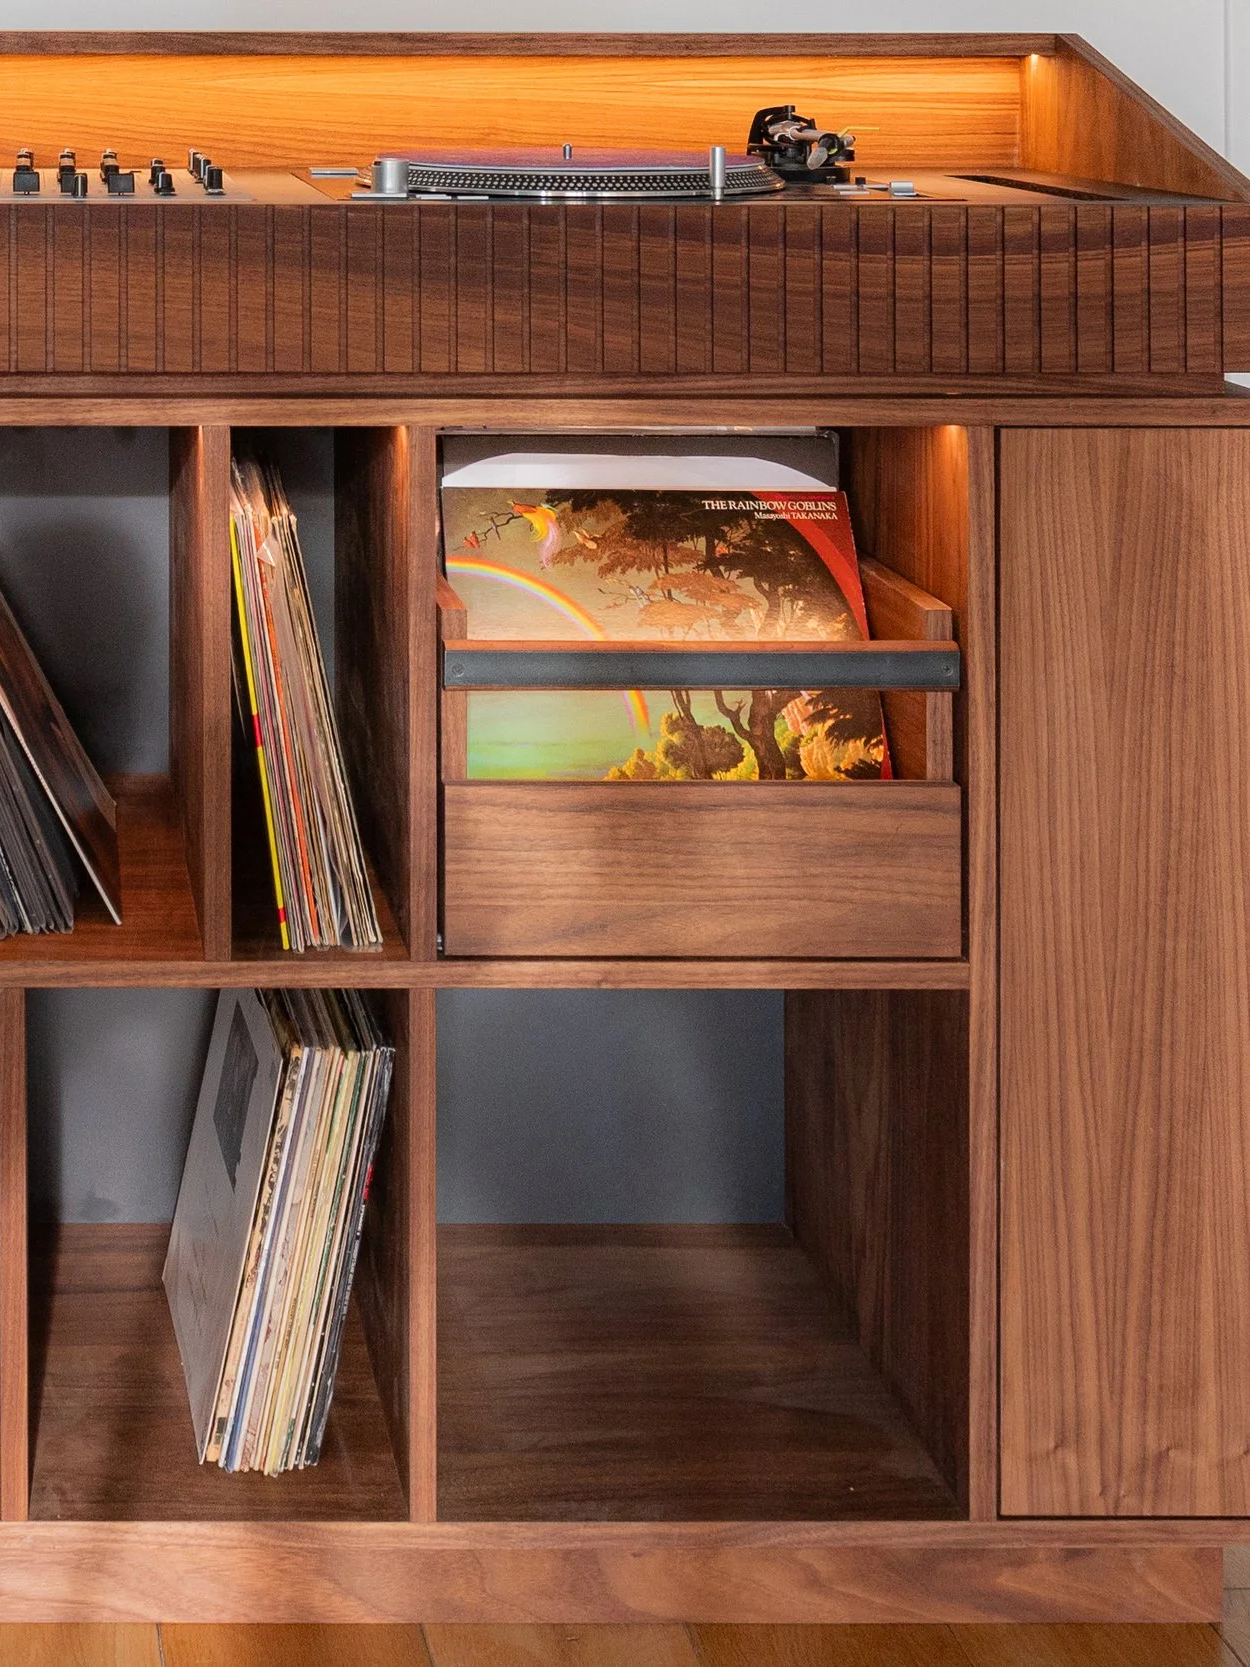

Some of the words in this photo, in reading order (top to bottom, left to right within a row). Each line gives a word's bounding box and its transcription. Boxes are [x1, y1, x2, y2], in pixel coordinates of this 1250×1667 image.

[701, 500, 728, 510] THE
[728, 500, 788, 511] RAINBOW
[788, 501, 837, 511] GOBLINS
[754, 512, 791, 521] Masayoshi
[791, 512, 838, 520] TAKANAKA
